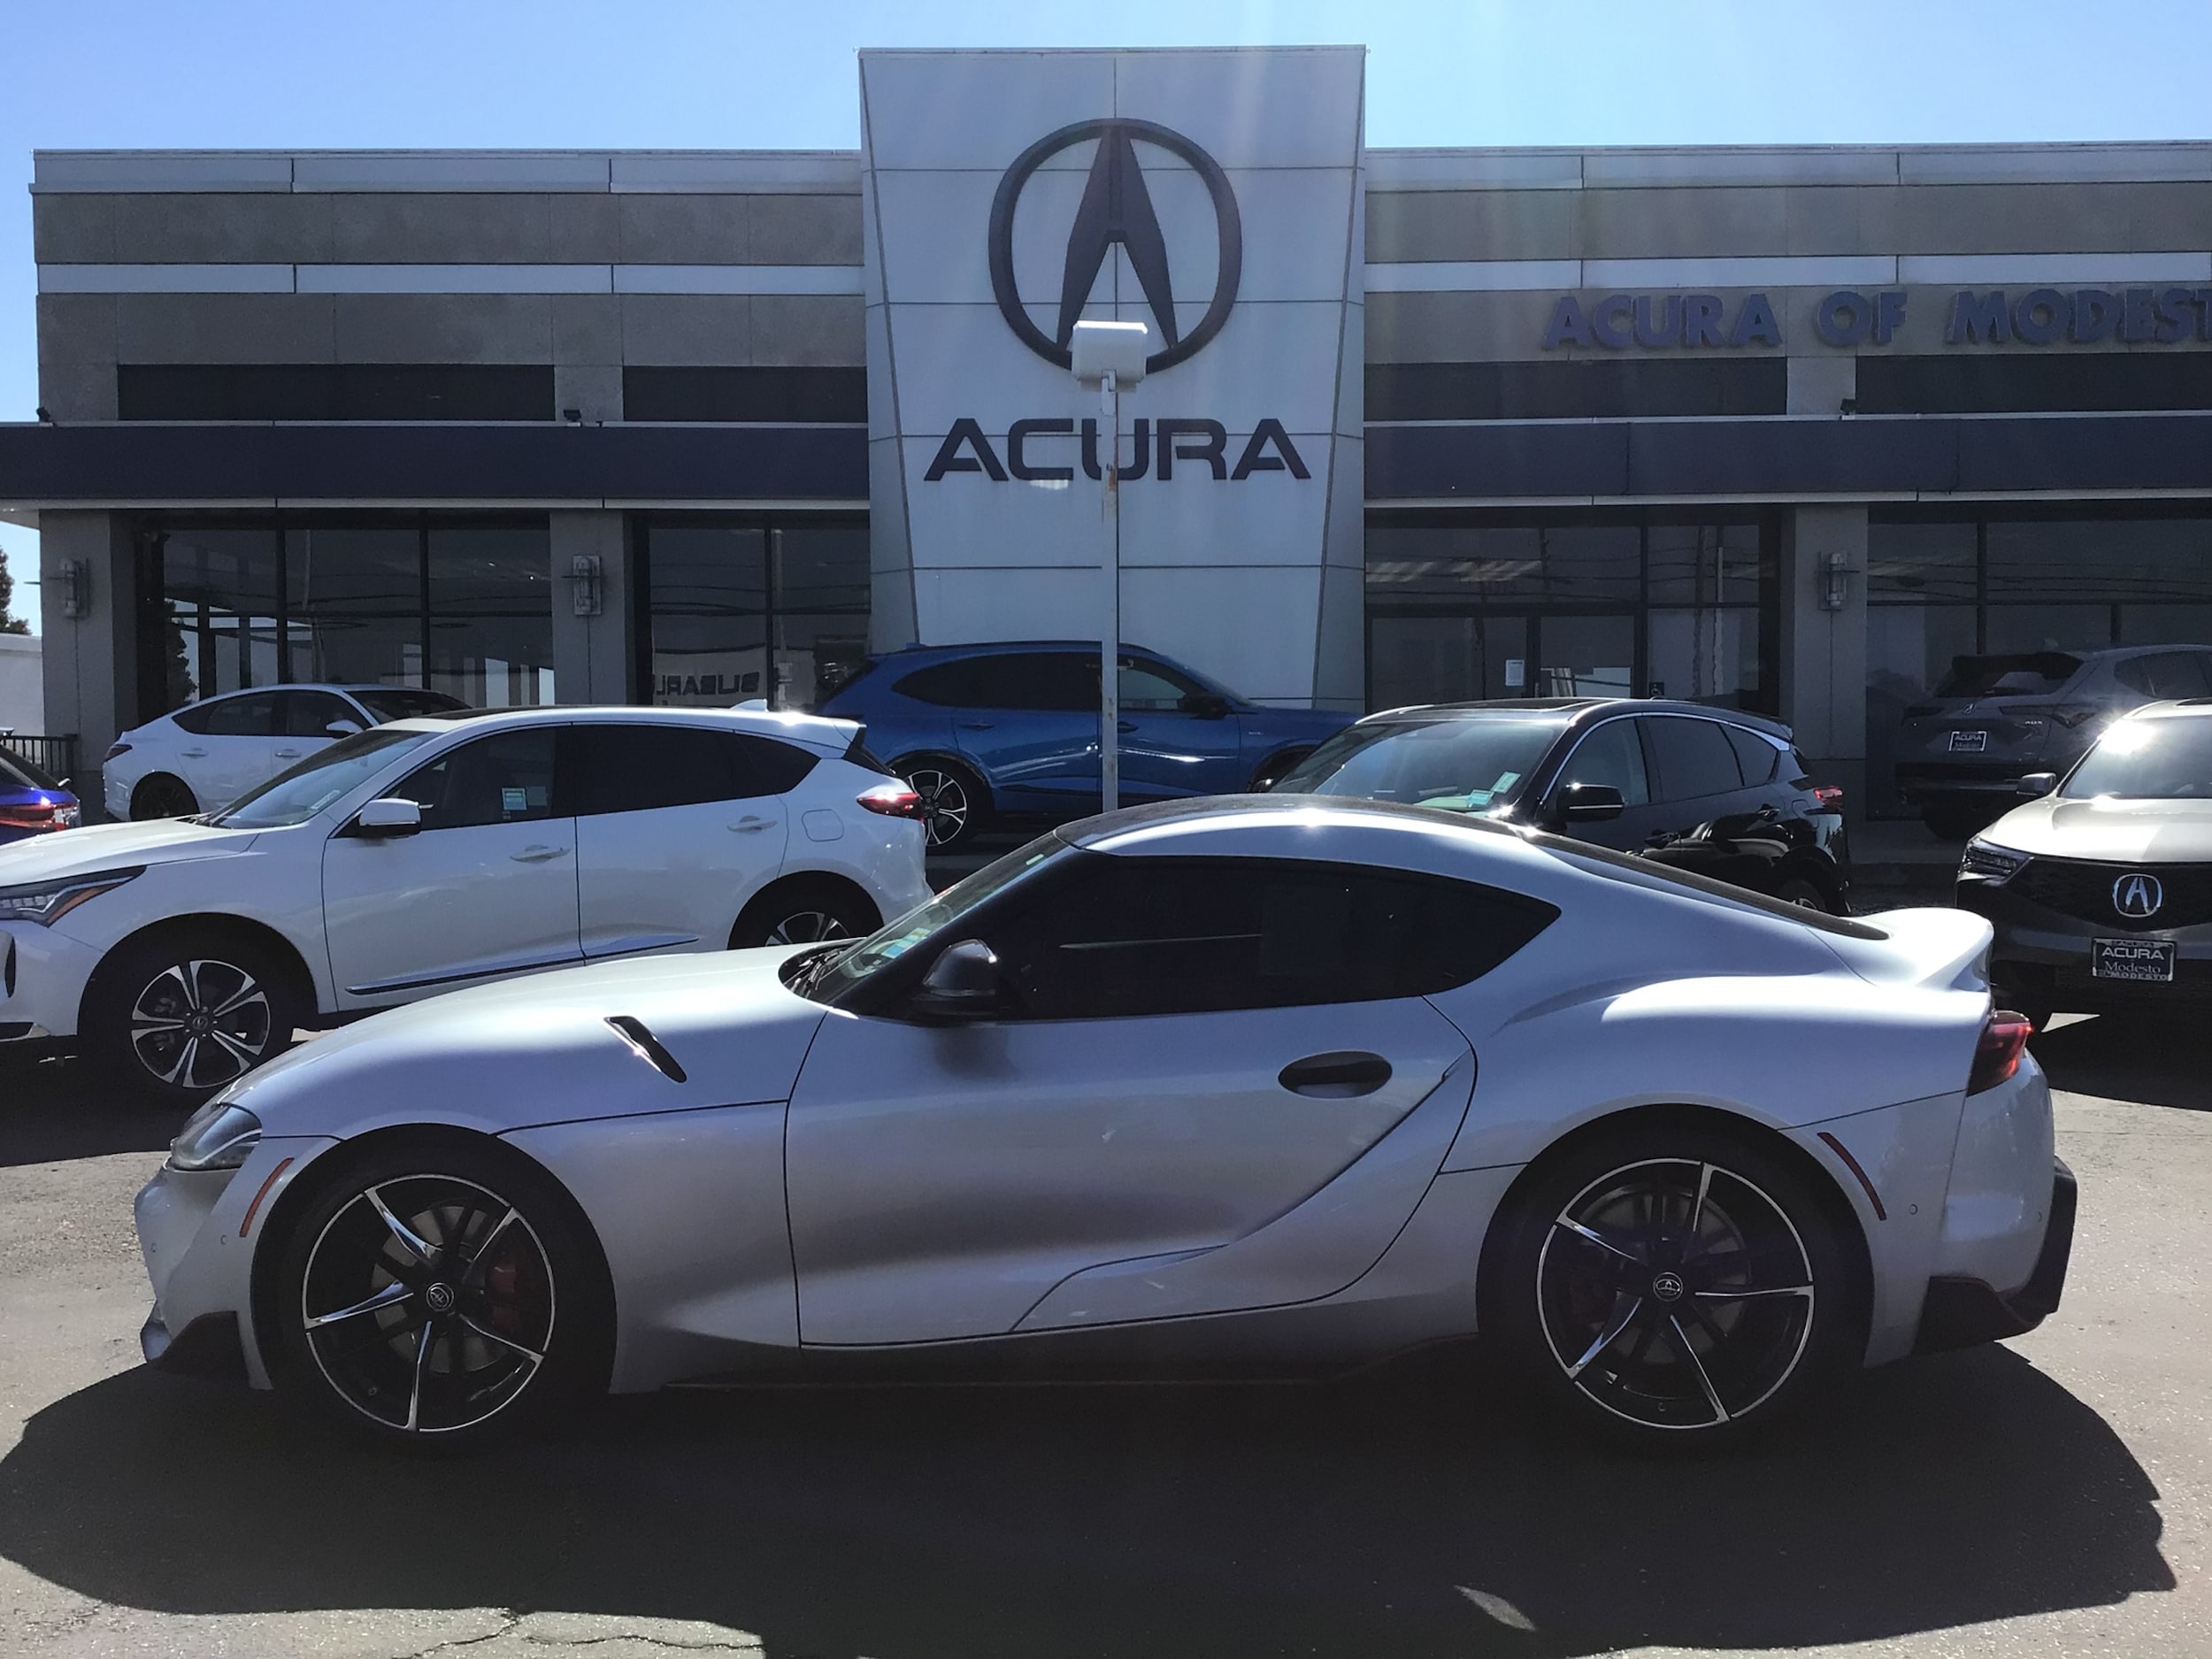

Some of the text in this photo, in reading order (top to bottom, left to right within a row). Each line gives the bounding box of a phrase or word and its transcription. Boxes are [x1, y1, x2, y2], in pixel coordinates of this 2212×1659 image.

[1542, 293, 1784, 349] ACURA
[1816, 291, 1909, 347] OF
[923, 418, 1312, 481] ACURA
[2101, 947, 2165, 960] ACURA
[2105, 961, 2162, 974] Modesto
